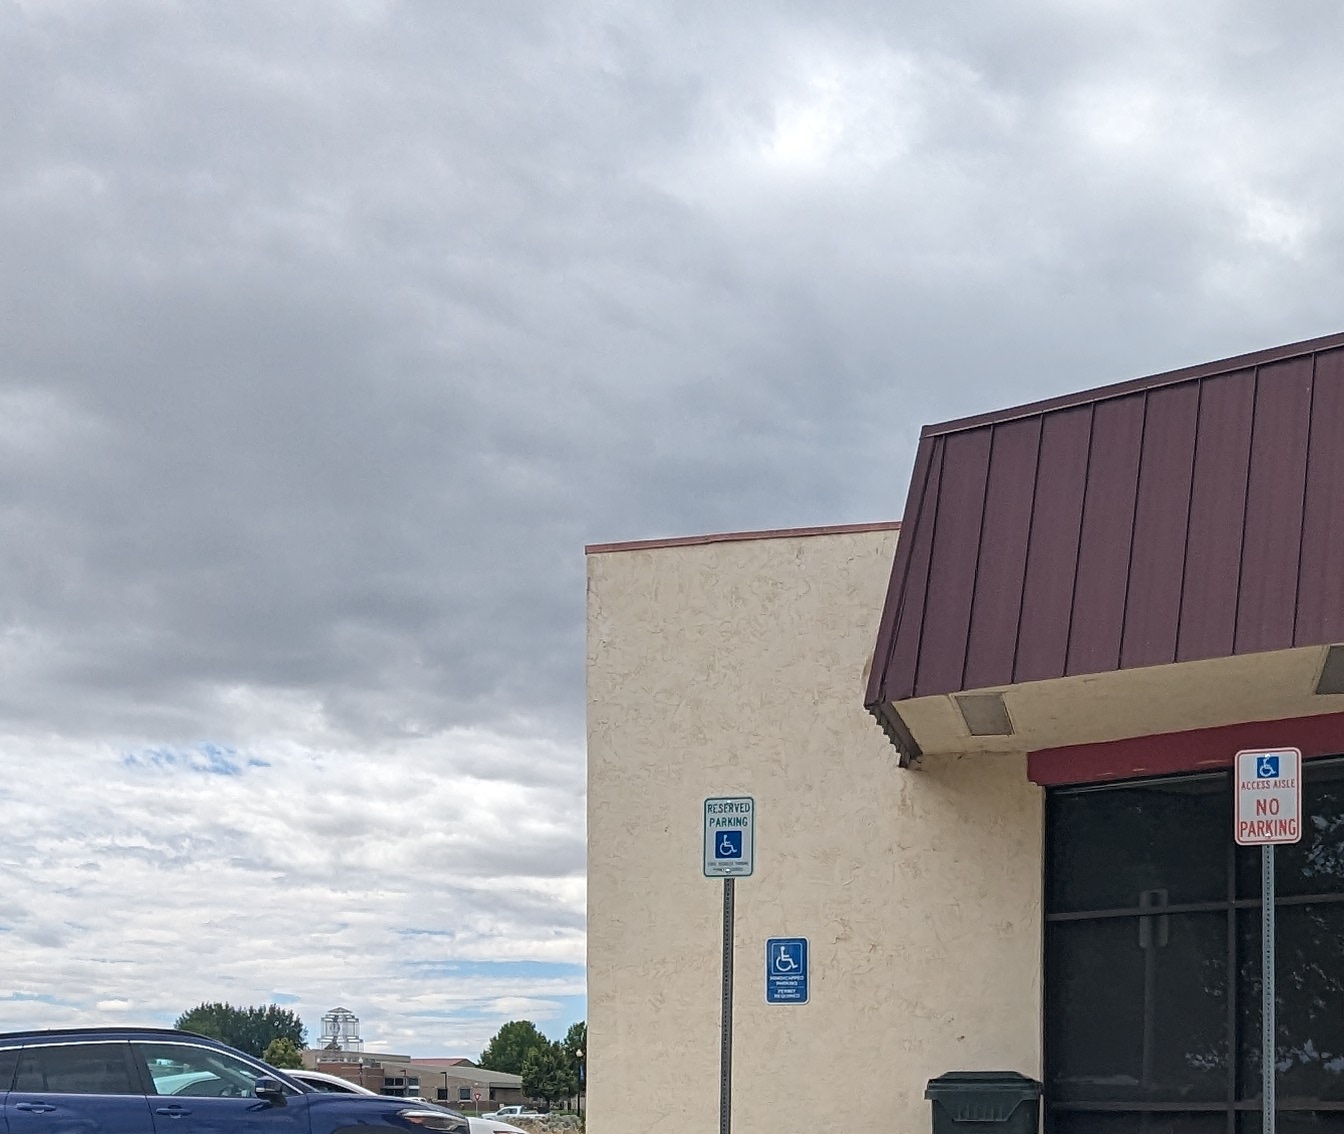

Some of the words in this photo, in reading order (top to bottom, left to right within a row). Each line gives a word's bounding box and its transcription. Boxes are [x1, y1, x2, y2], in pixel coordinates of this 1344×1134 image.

[1241, 780, 1271, 791] ACCESS
[1273, 778, 1296, 789] AISLE
[707, 802, 751, 814] RESERVED
[1256, 798, 1280, 816] NO
[709, 817, 748, 828] PARKING
[1239, 819, 1297, 837] PARKING
